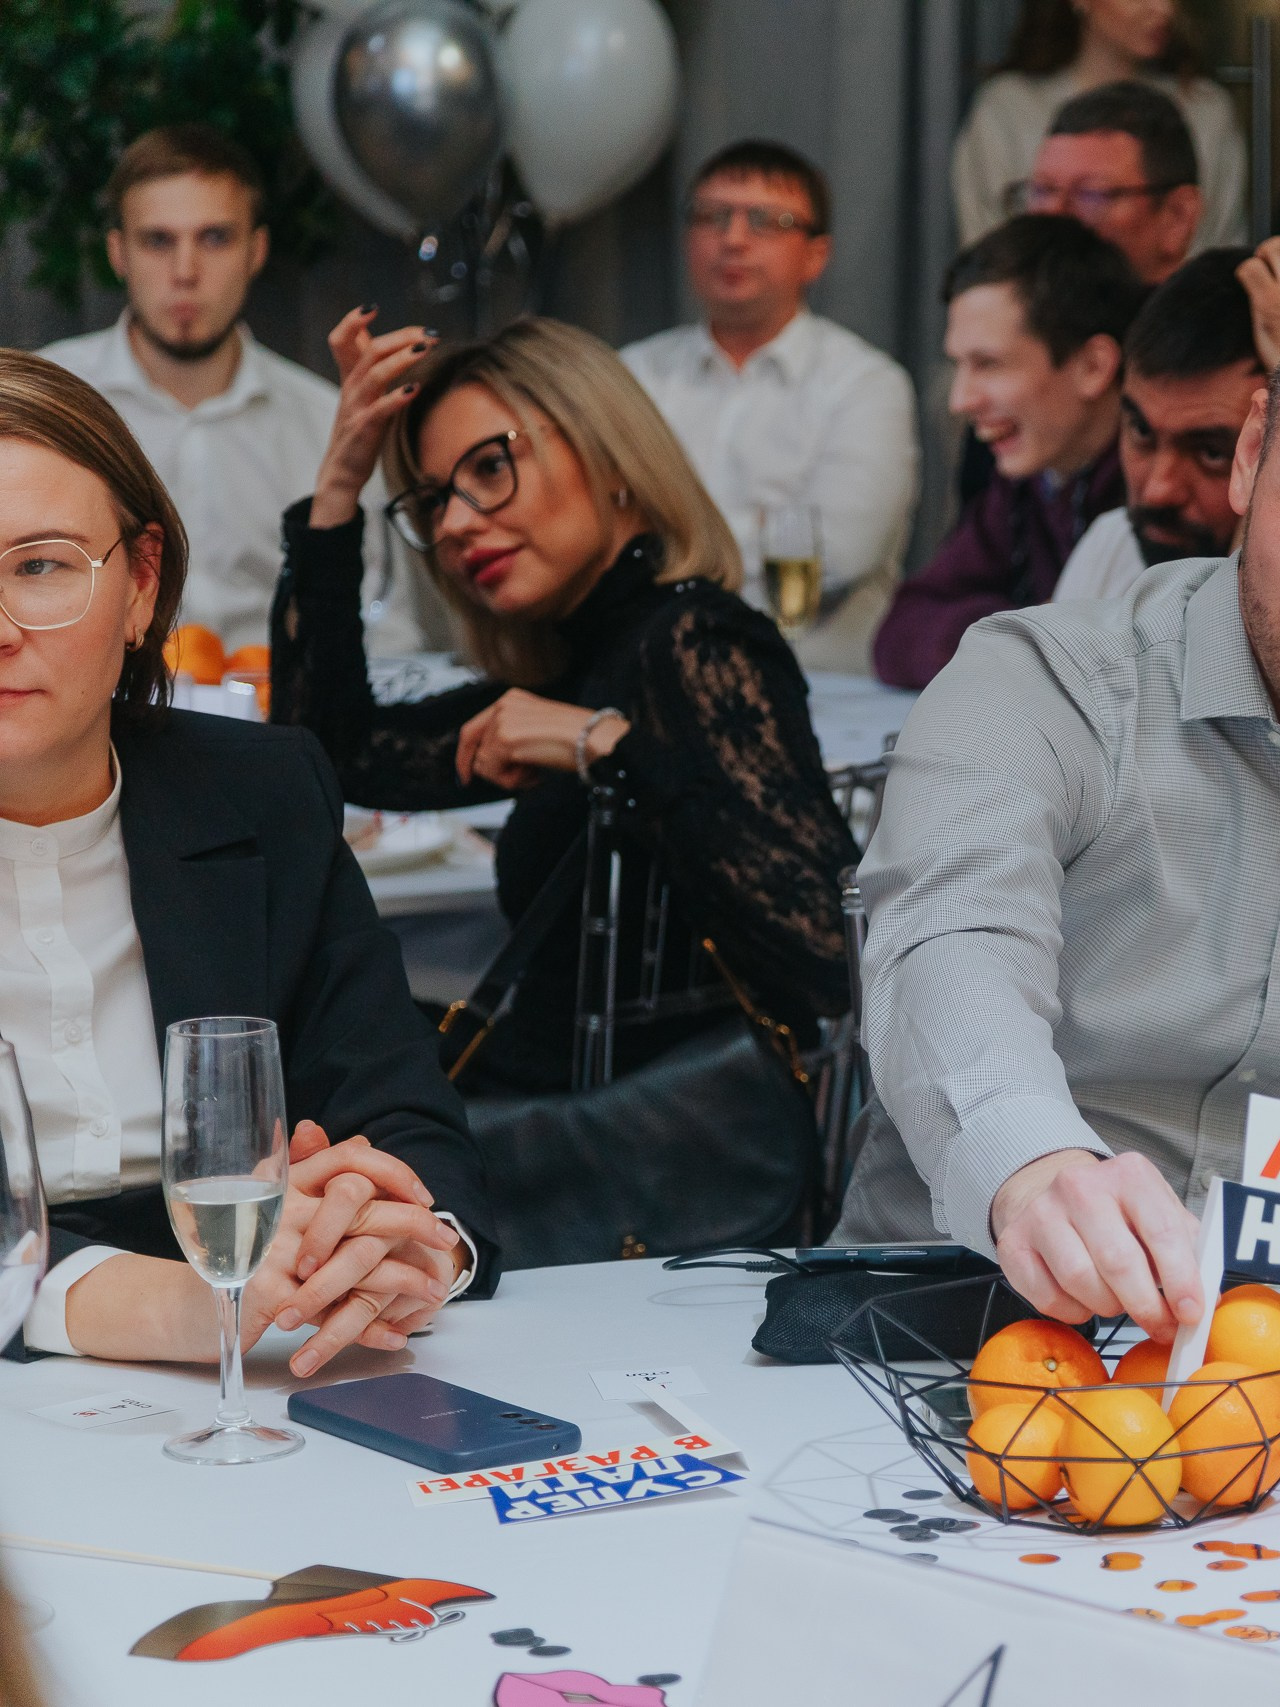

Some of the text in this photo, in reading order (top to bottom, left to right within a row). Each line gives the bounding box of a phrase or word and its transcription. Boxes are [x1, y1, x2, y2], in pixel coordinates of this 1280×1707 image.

[415, 1434, 713, 1494] В РАЗГАРЕ!
[498, 1455, 685, 1499] ПАТИ
[505, 1469, 723, 1520] СУПЕР
